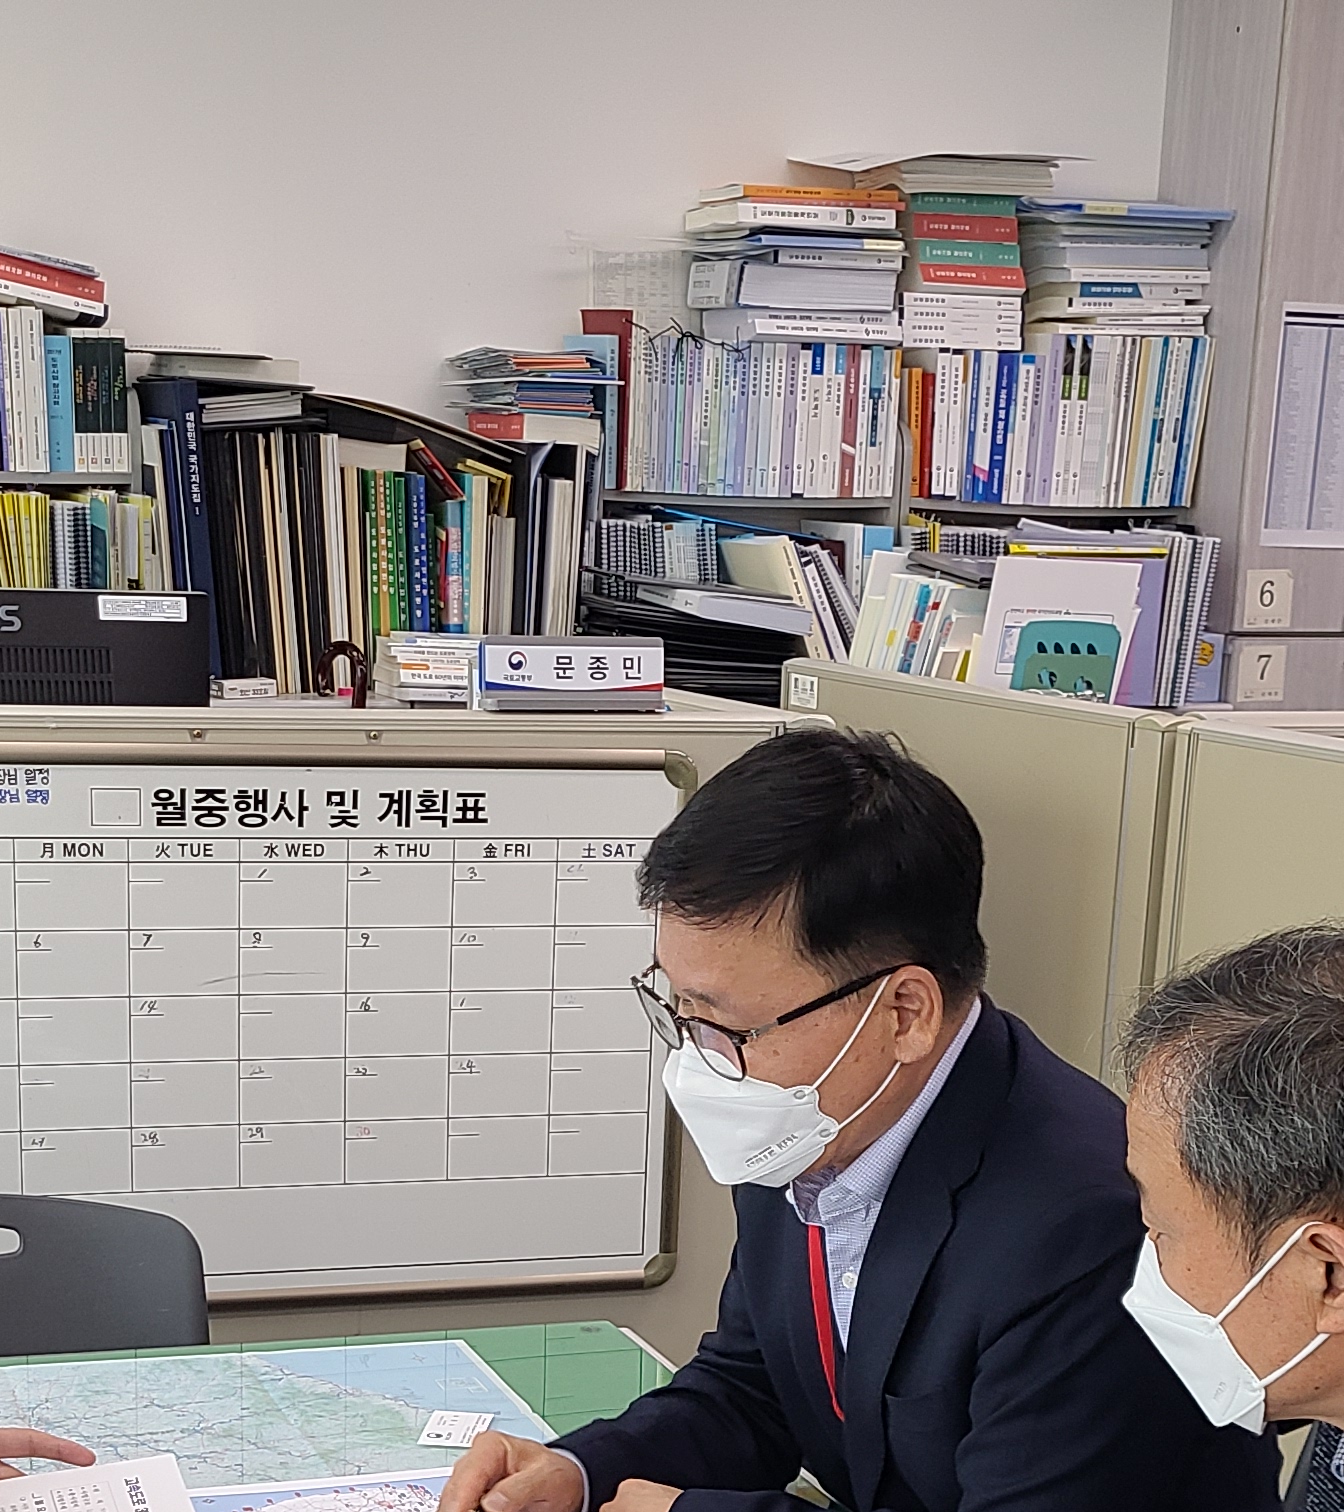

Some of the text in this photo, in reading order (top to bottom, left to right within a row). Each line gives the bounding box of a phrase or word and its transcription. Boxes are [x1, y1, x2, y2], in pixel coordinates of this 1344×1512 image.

[1258, 580, 1275, 608] 6
[1256, 654, 1272, 680] 7
[151, 788, 489, 829] 월중행사 및 계획표
[40, 843, 104, 858] 月 MON
[155, 843, 214, 859] 火 TUE
[262, 843, 325, 859] 水 WED
[373, 843, 431, 859] 木 THU
[482, 843, 532, 859] 金 FRI
[581, 843, 636, 859] 土 SAT
[359, 866, 373, 878] 2
[467, 866, 479, 880] 3
[32, 934, 42, 949] 6
[142, 934, 154, 948] 7
[359, 932, 371, 948] 9
[246, 1126, 265, 1140] 29
[124, 1476, 147, 1506] 고속도로
